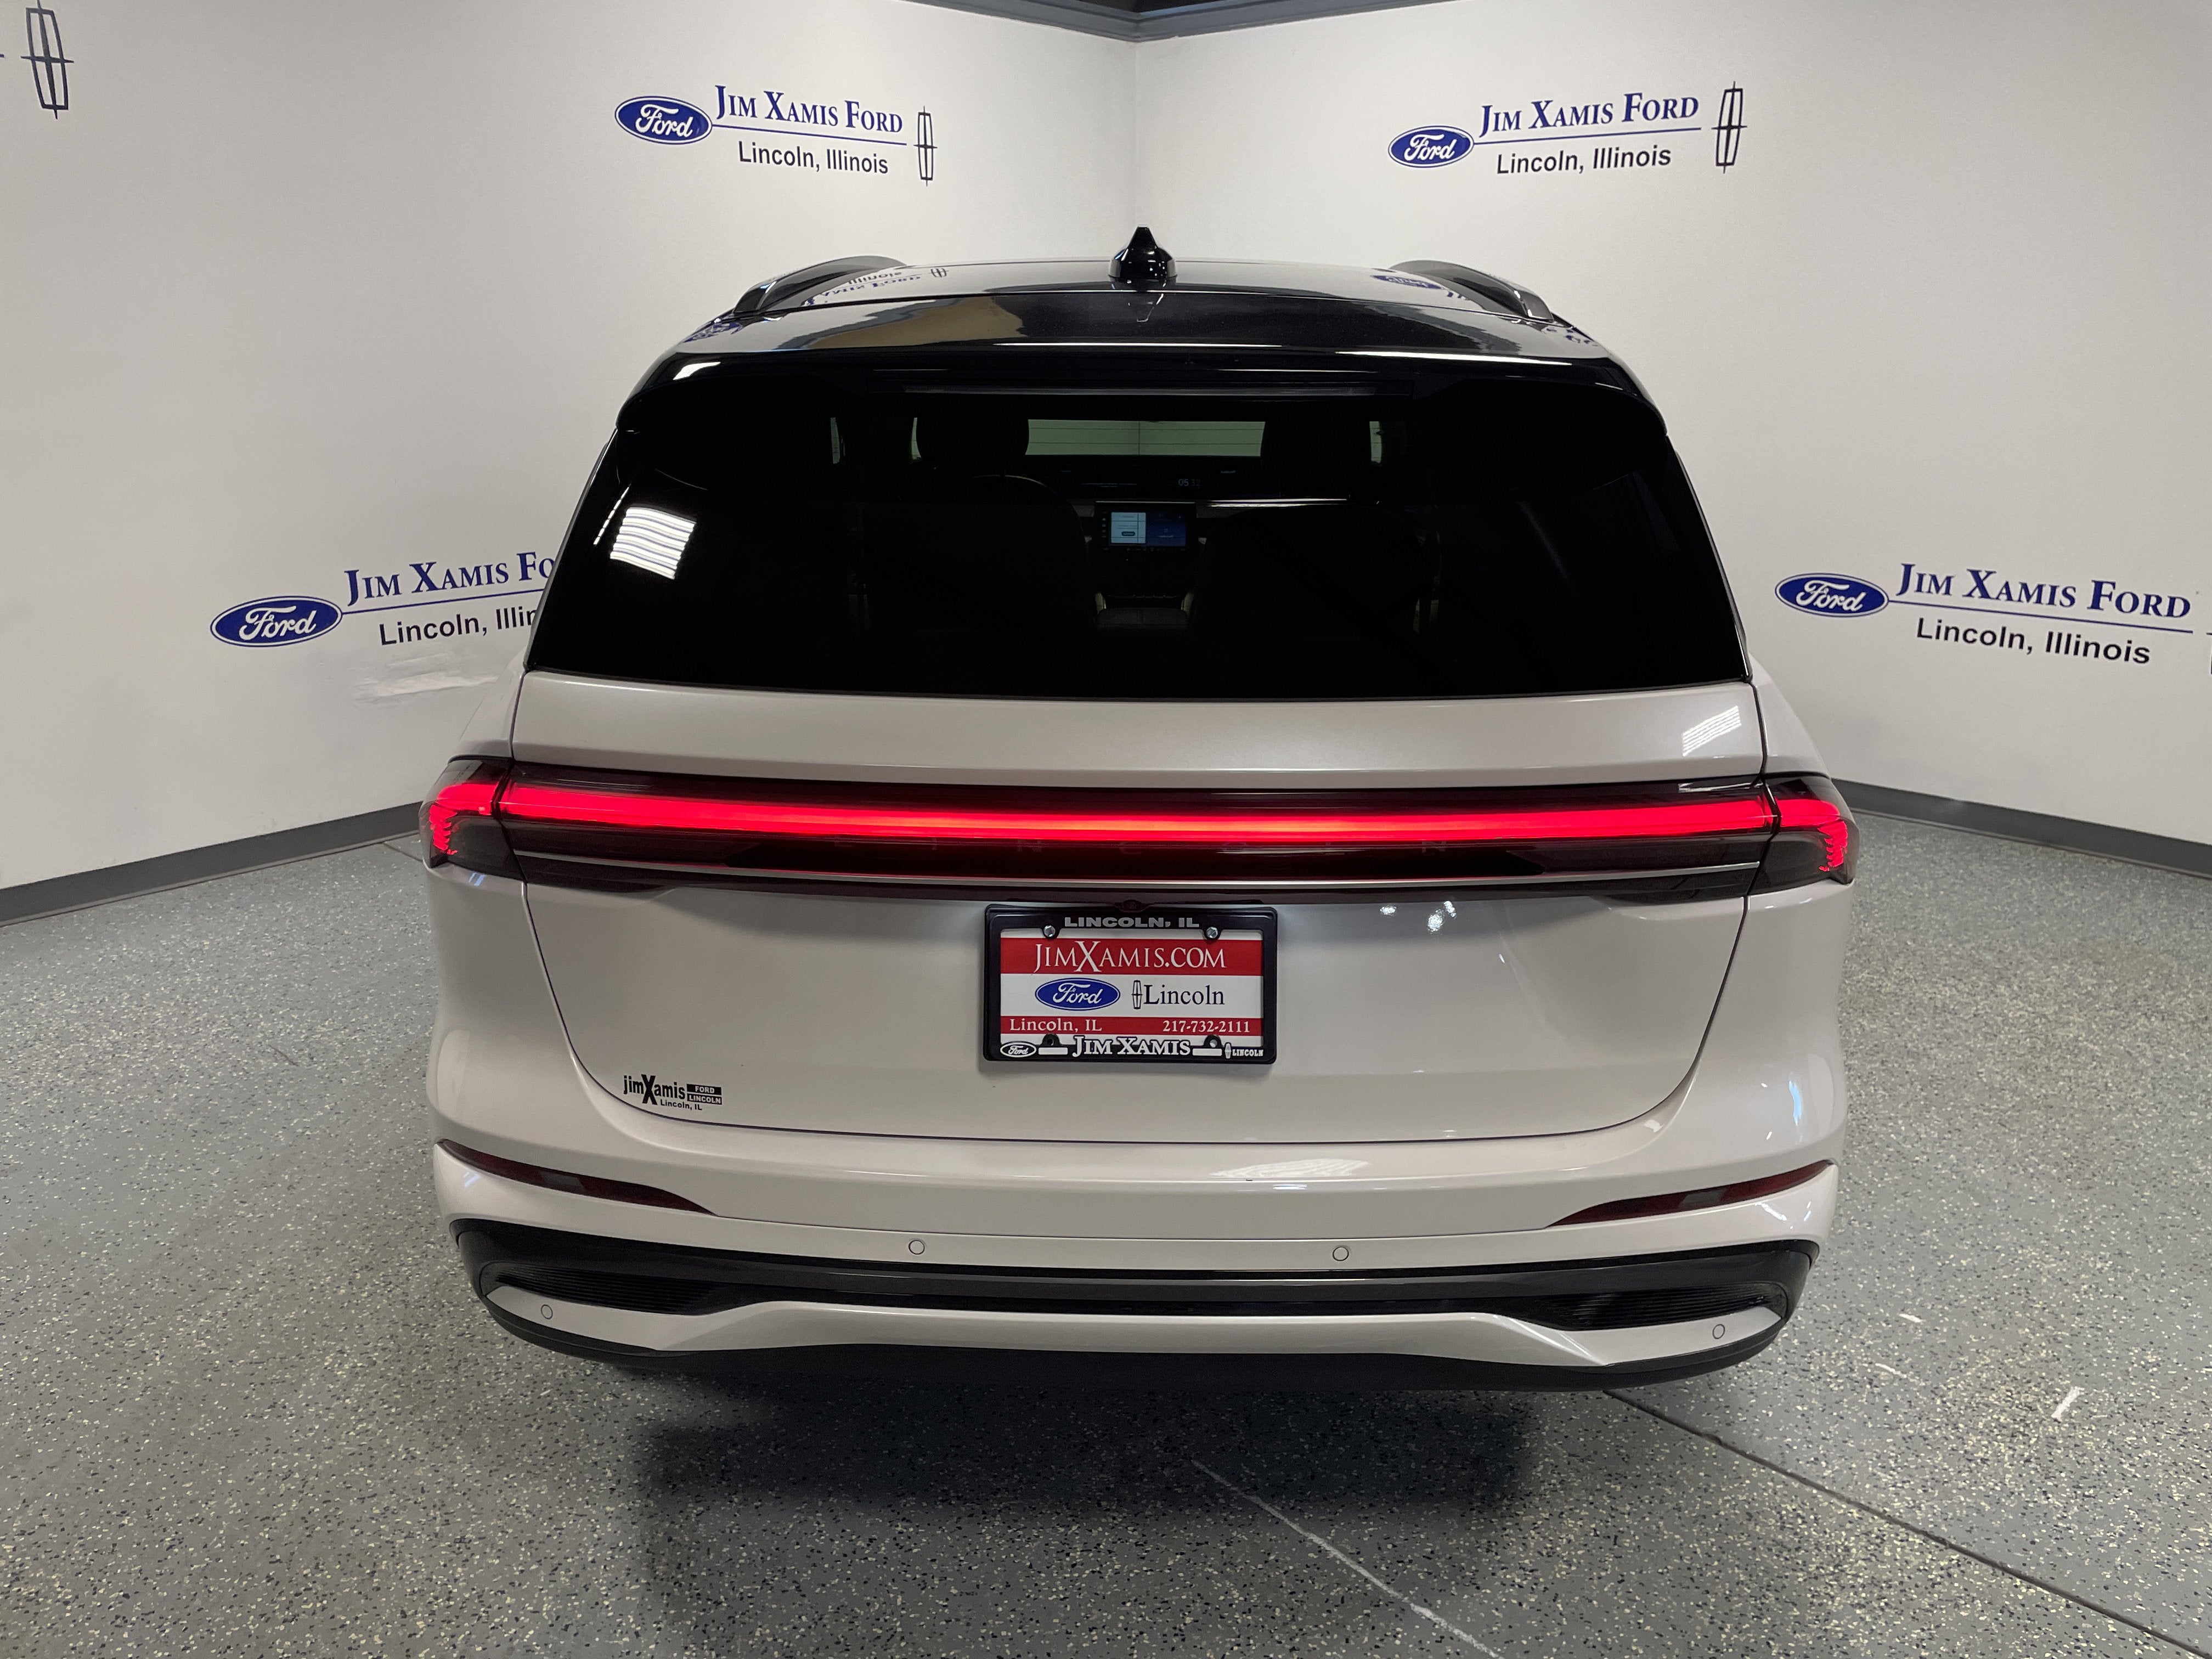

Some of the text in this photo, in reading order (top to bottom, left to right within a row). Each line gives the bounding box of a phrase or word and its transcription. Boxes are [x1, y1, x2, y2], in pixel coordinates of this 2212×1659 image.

[635, 104, 694, 137] Ford
[715, 85, 902, 133] JIM XAMIS FORD
[1479, 92, 1699, 138] JIM XAMIS FORD
[738, 140, 888, 174] Lincoln, Illinois
[1404, 133, 1456, 161] Ford
[1497, 144, 1671, 174] Lincoln, Illinois
[344, 552, 555, 607] JIM XAMIS FO
[1896, 563, 2191, 618] JIM XAMIS FORD
[1796, 579, 1867, 613] Ford
[239, 605, 317, 641] Ford
[379, 606, 537, 646] Lincoln, Illin
[1917, 617, 2151, 664] Lincoln, Illinois
[1064, 917, 1199, 928] LINCOLN, IL
[1034, 940, 1227, 973] JIMXAMIS.COM
[1052, 982, 1103, 1005] Ford
[1143, 984, 1225, 1005] Lincoln
[1009, 1018, 1103, 1034] Lincoln, IL
[1163, 1020, 1250, 1033] 217-732-2111
[1007, 1045, 1029, 1056] Ford
[1072, 1035, 1191, 1058] JIM XAMIS
[1232, 1048, 1264, 1057] LINCOLN
[660, 1099, 693, 1111] Lincoln,
[689, 1094, 721, 1104] LINCOLN
